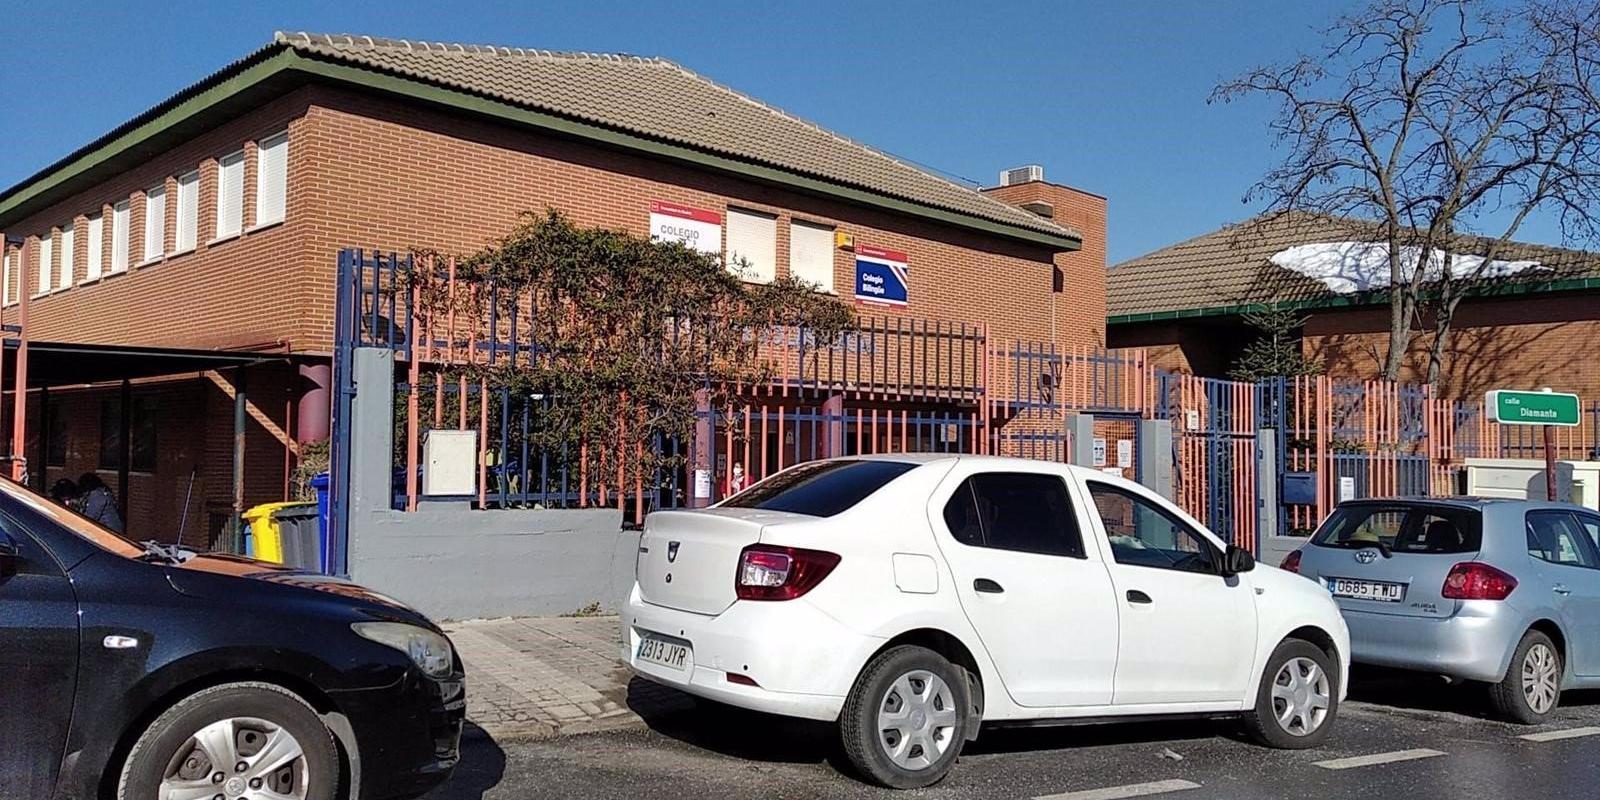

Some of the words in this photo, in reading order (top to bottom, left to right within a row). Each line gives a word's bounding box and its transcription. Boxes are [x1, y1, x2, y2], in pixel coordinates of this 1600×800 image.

[660, 224, 700, 240] COLEGIO
[862, 272, 884, 285] Colegio
[1504, 397, 1520, 405] calle
[1520, 407, 1557, 418] Diamante
[1337, 580, 1368, 595] 0685
[1372, 584, 1398, 598] FWD
[641, 639, 664, 660] 2313
[664, 645, 686, 667] JYR
